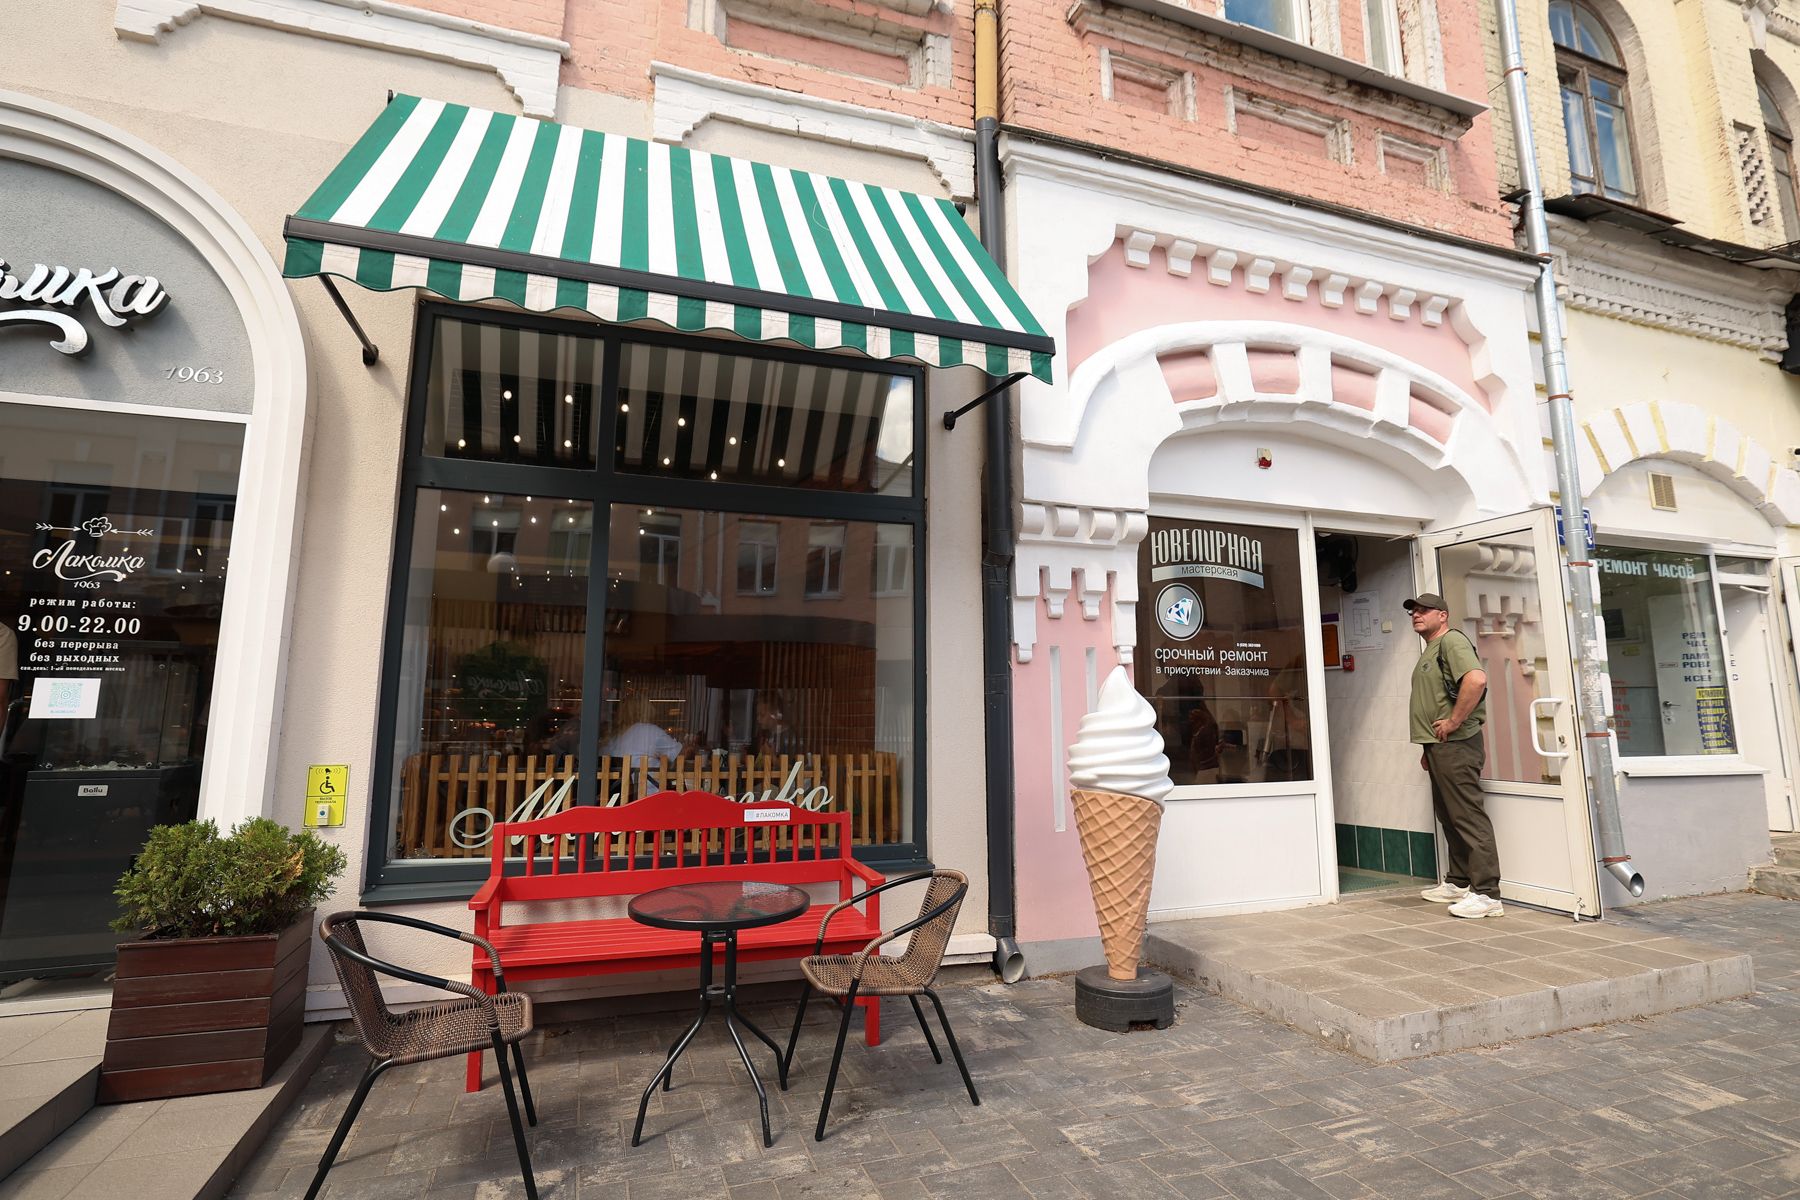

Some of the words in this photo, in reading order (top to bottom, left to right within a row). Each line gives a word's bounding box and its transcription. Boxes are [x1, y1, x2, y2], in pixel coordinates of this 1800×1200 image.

[0, 257, 166, 355] мка
[163, 365, 225, 385] 1963
[1150, 528, 1263, 573] ЮВЕЛИРНАЯ
[32, 539, 146, 583] Лакомка
[1596, 558, 1648, 576] РЕМОНТ
[1653, 563, 1695, 579] ЧАСОВ
[1181, 565, 1239, 578] мастерская
[73, 580, 101, 589] 1963
[29, 598, 76, 608] режим
[82, 598, 136, 609] работы:
[17, 614, 141, 635] 9.00-22.00
[34, 638, 55, 648] без
[60, 640, 119, 651] перерыва
[29, 652, 50, 662] без
[55, 654, 120, 664] выходных
[1154, 646, 1215, 663] срочный
[1219, 650, 1268, 664] ремонт
[1155, 666, 1162, 674] в
[1164, 666, 1221, 677] присутствии
[1224, 665, 1270, 676] Заказчика
[755, 811, 789, 819] #ЛАКОМКА
